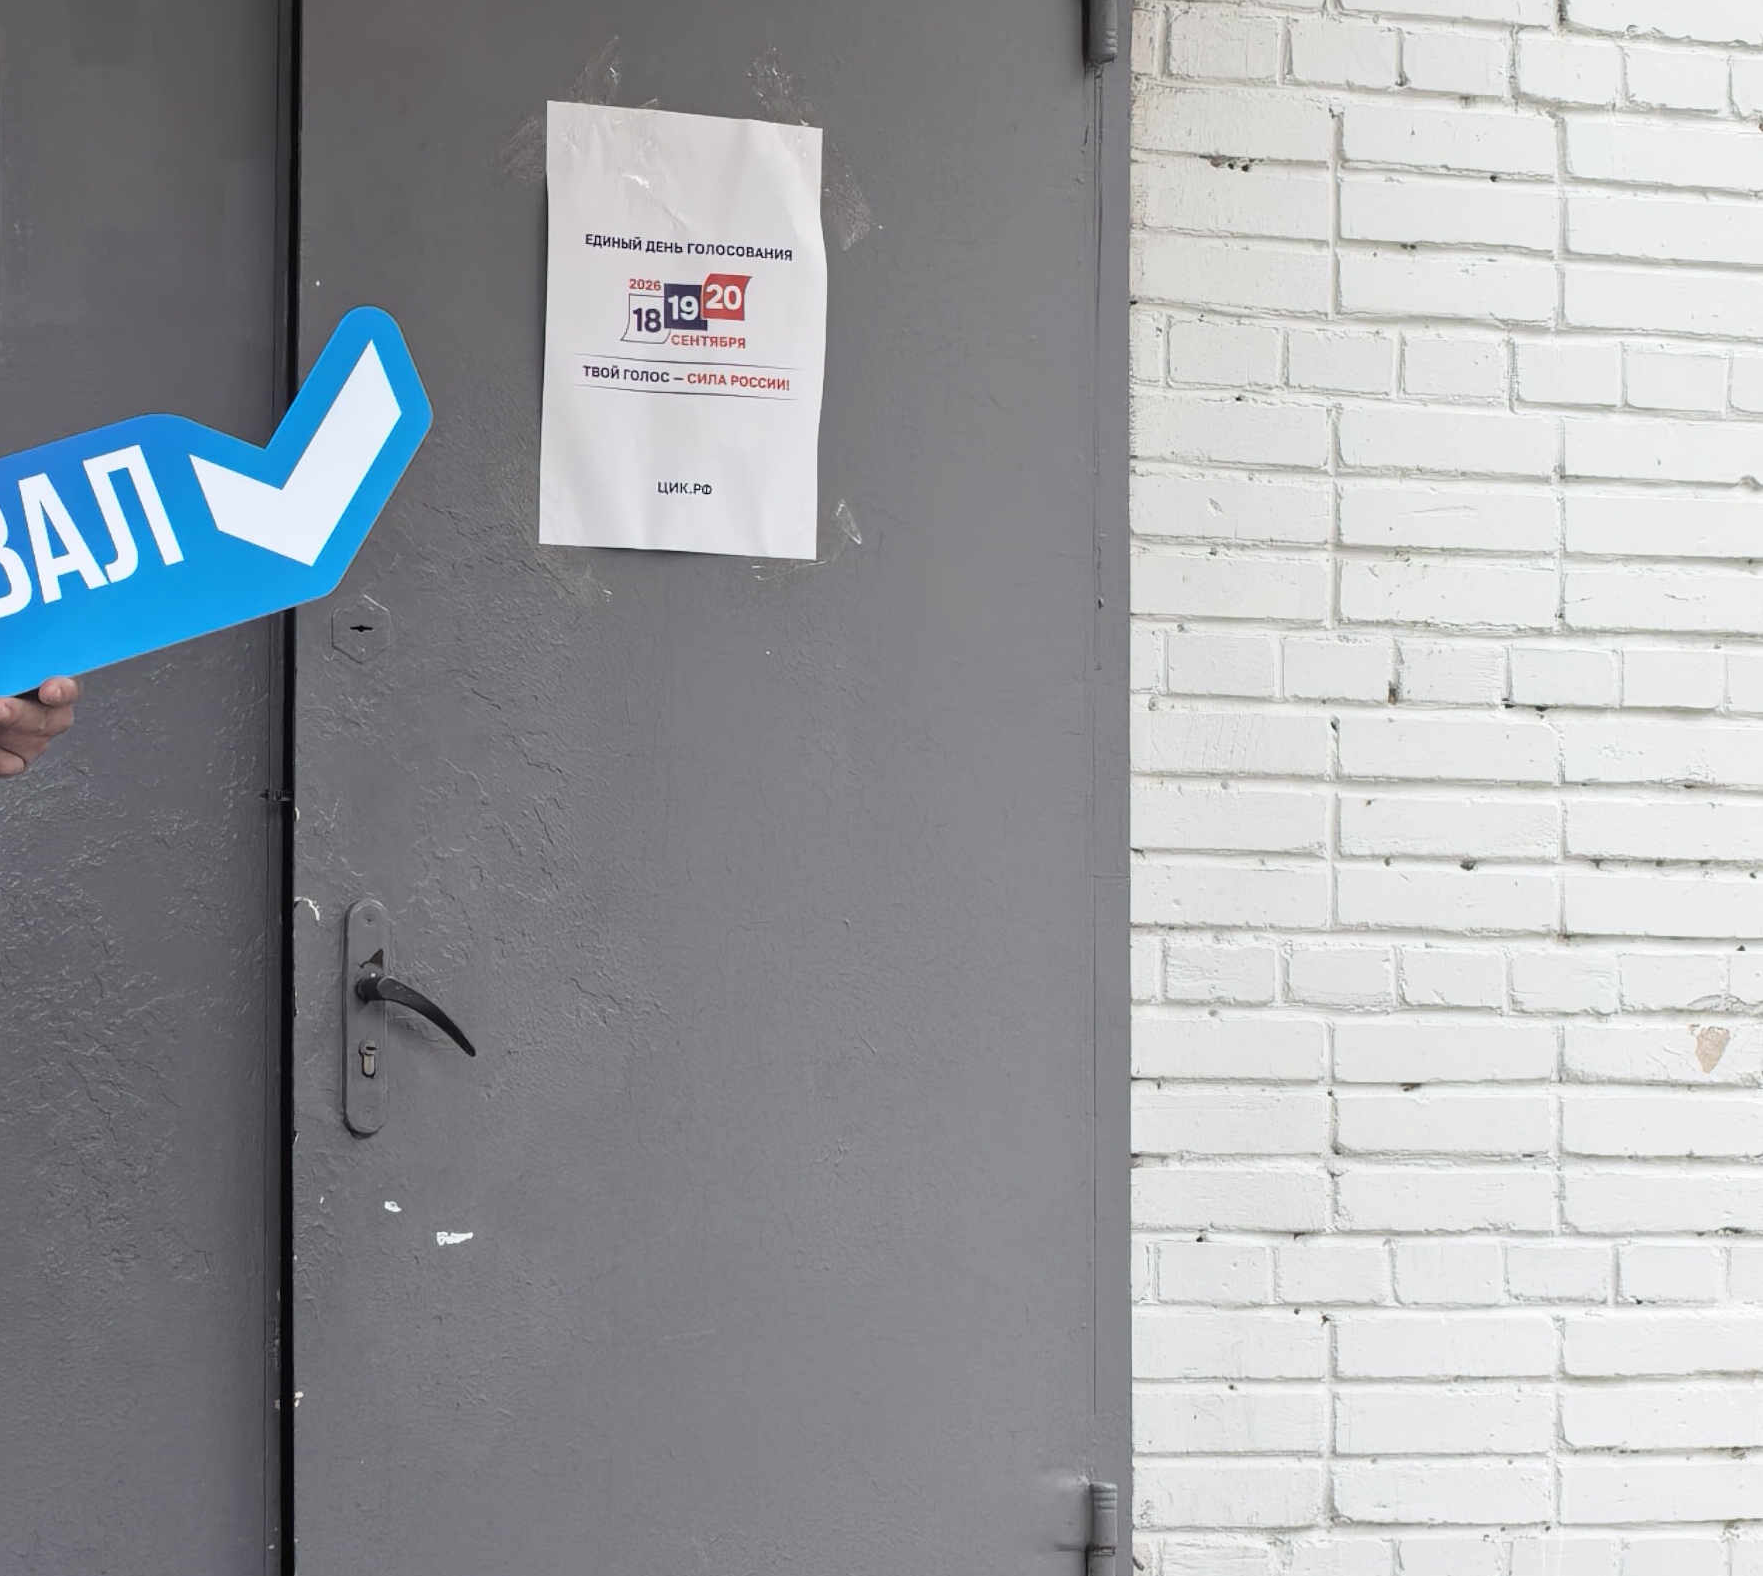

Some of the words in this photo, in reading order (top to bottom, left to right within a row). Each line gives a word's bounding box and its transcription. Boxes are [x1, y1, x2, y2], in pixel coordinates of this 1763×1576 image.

[584, 233, 642, 251] ЕДИНЫЙ
[645, 240, 683, 254] ДЕНЬ
[687, 243, 793, 261] ГОЛОСОВАНИЯ
[629, 278, 662, 291] 2026
[632, 307, 662, 333] 18
[667, 295, 699, 321] 19
[705, 284, 743, 311] 20
[670, 334, 746, 349] СЕНТЯБРЯ
[582, 364, 620, 379] ТВОЙ
[623, 369, 670, 383] ГОЛОС
[687, 373, 727, 386] СИЛА
[730, 375, 790, 391] РОССИИ!
[656, 480, 713, 497] ЦИК.РФ
